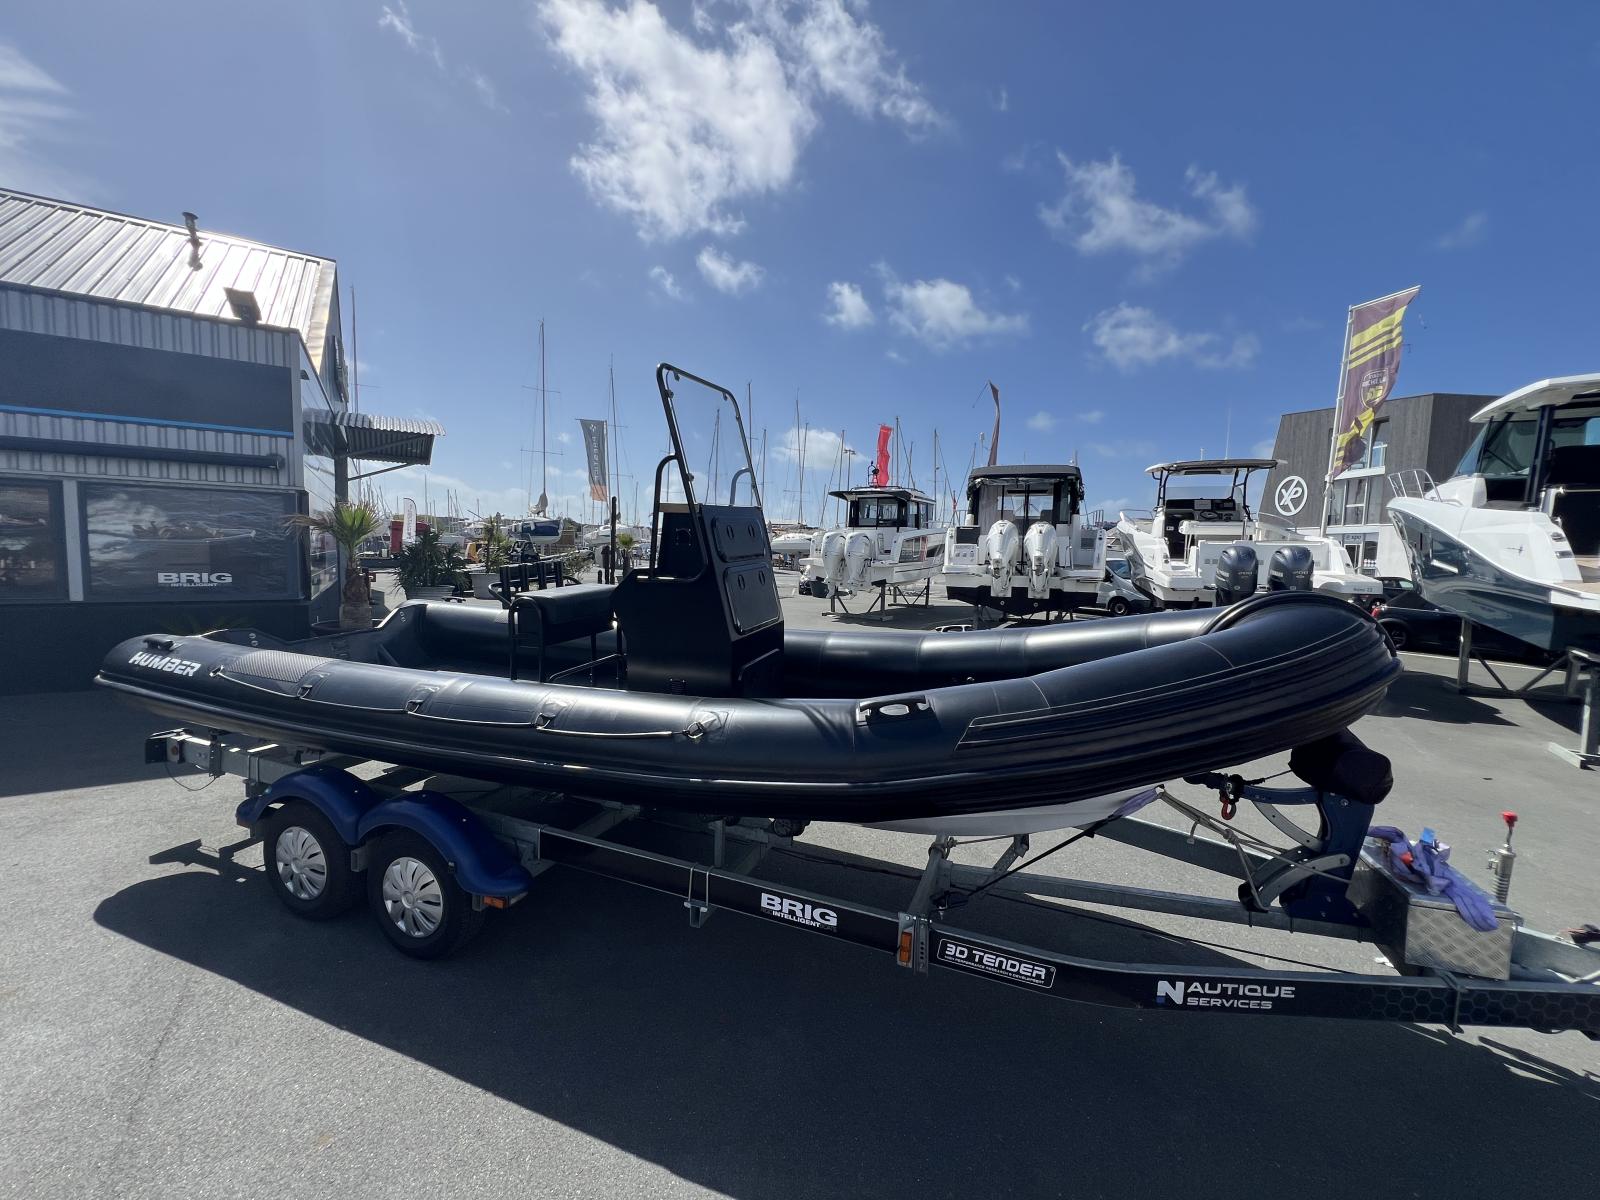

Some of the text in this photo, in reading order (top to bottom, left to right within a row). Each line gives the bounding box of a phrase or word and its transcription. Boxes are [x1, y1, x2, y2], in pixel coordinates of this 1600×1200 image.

[158, 572, 232, 583] BRIG
[128, 650, 201, 678] HUMBER
[761, 892, 838, 926] BRIG
[772, 910, 821, 928] INTELLIGENT
[945, 943, 1047, 980] 3D TENDER
[1186, 996, 1273, 1010] SERVICES
